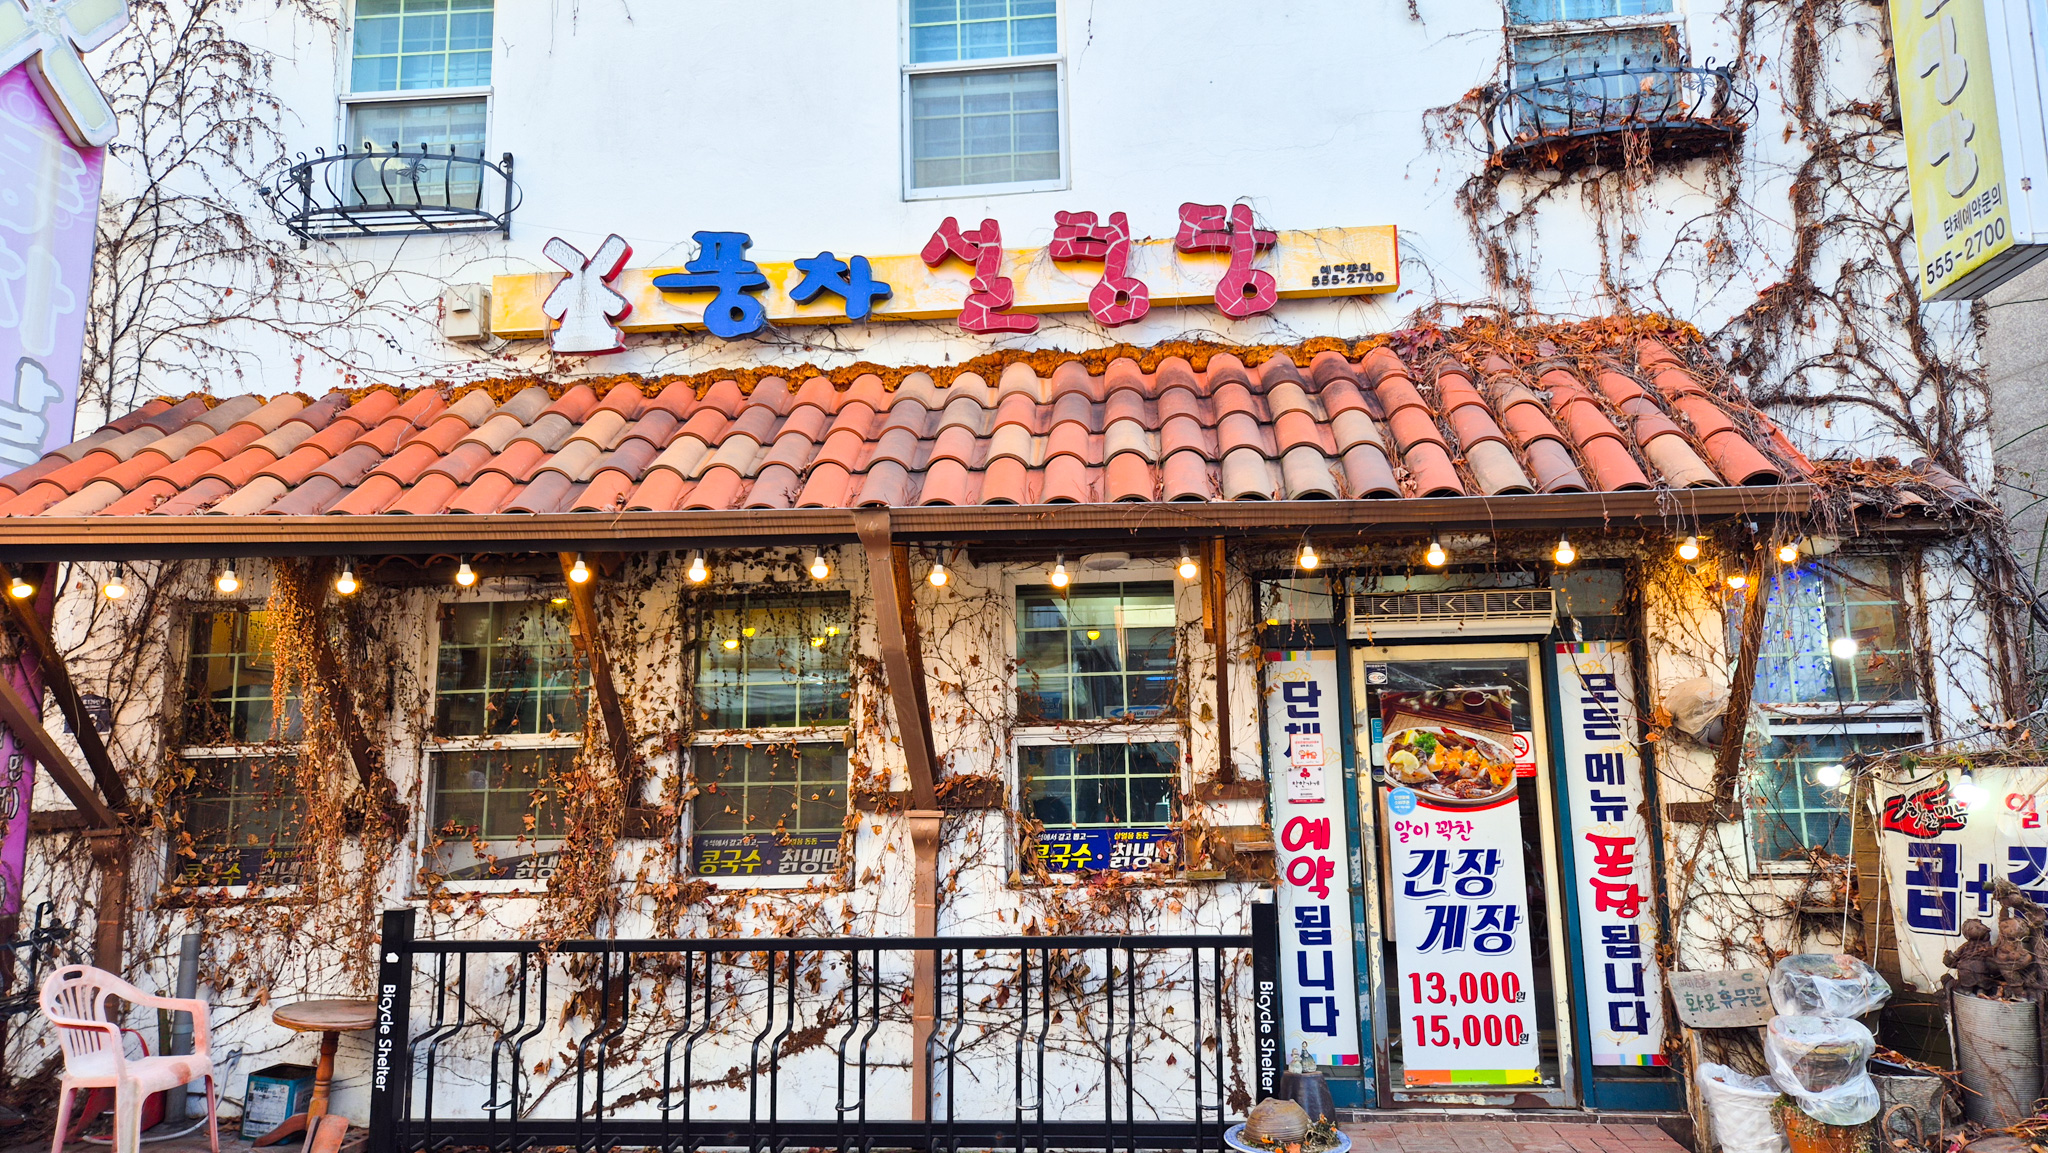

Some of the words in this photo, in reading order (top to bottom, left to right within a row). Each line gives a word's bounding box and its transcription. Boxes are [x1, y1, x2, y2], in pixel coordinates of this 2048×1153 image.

[1943, 183, 2002, 241] 단체예약문의
[653, 231, 894, 341] 풍차
[920, 202, 1278, 335] 설렁탕
[1926, 217, 2006, 285] 555-2700
[1312, 272, 1385, 287] 555-2700
[1581, 673, 1621, 740] 모든
[1585, 753, 1628, 822] 메뉴
[1281, 816, 1335, 900] 예약
[1394, 820, 1429, 843] 알이
[1435, 820, 1475, 842] 꽉찬
[699, 849, 761, 874] 콩국수
[778, 848, 840, 874] 칡냉면
[1402, 849, 1502, 897] 간장
[1585, 833, 1648, 918] 포장
[1416, 905, 1521, 953] 게장
[1295, 905, 1339, 1037] 됩니다
[1408, 972, 1526, 1006] 13,000원
[1601, 924, 1650, 1036] 됩니다
[378, 984, 397, 1035] Bicycle
[1256, 981, 1274, 1034] Bicycle
[1412, 1014, 1530, 1049] 15,000원
[375, 1040, 393, 1092] Shelter
[1261, 1038, 1276, 1094] Shelter
